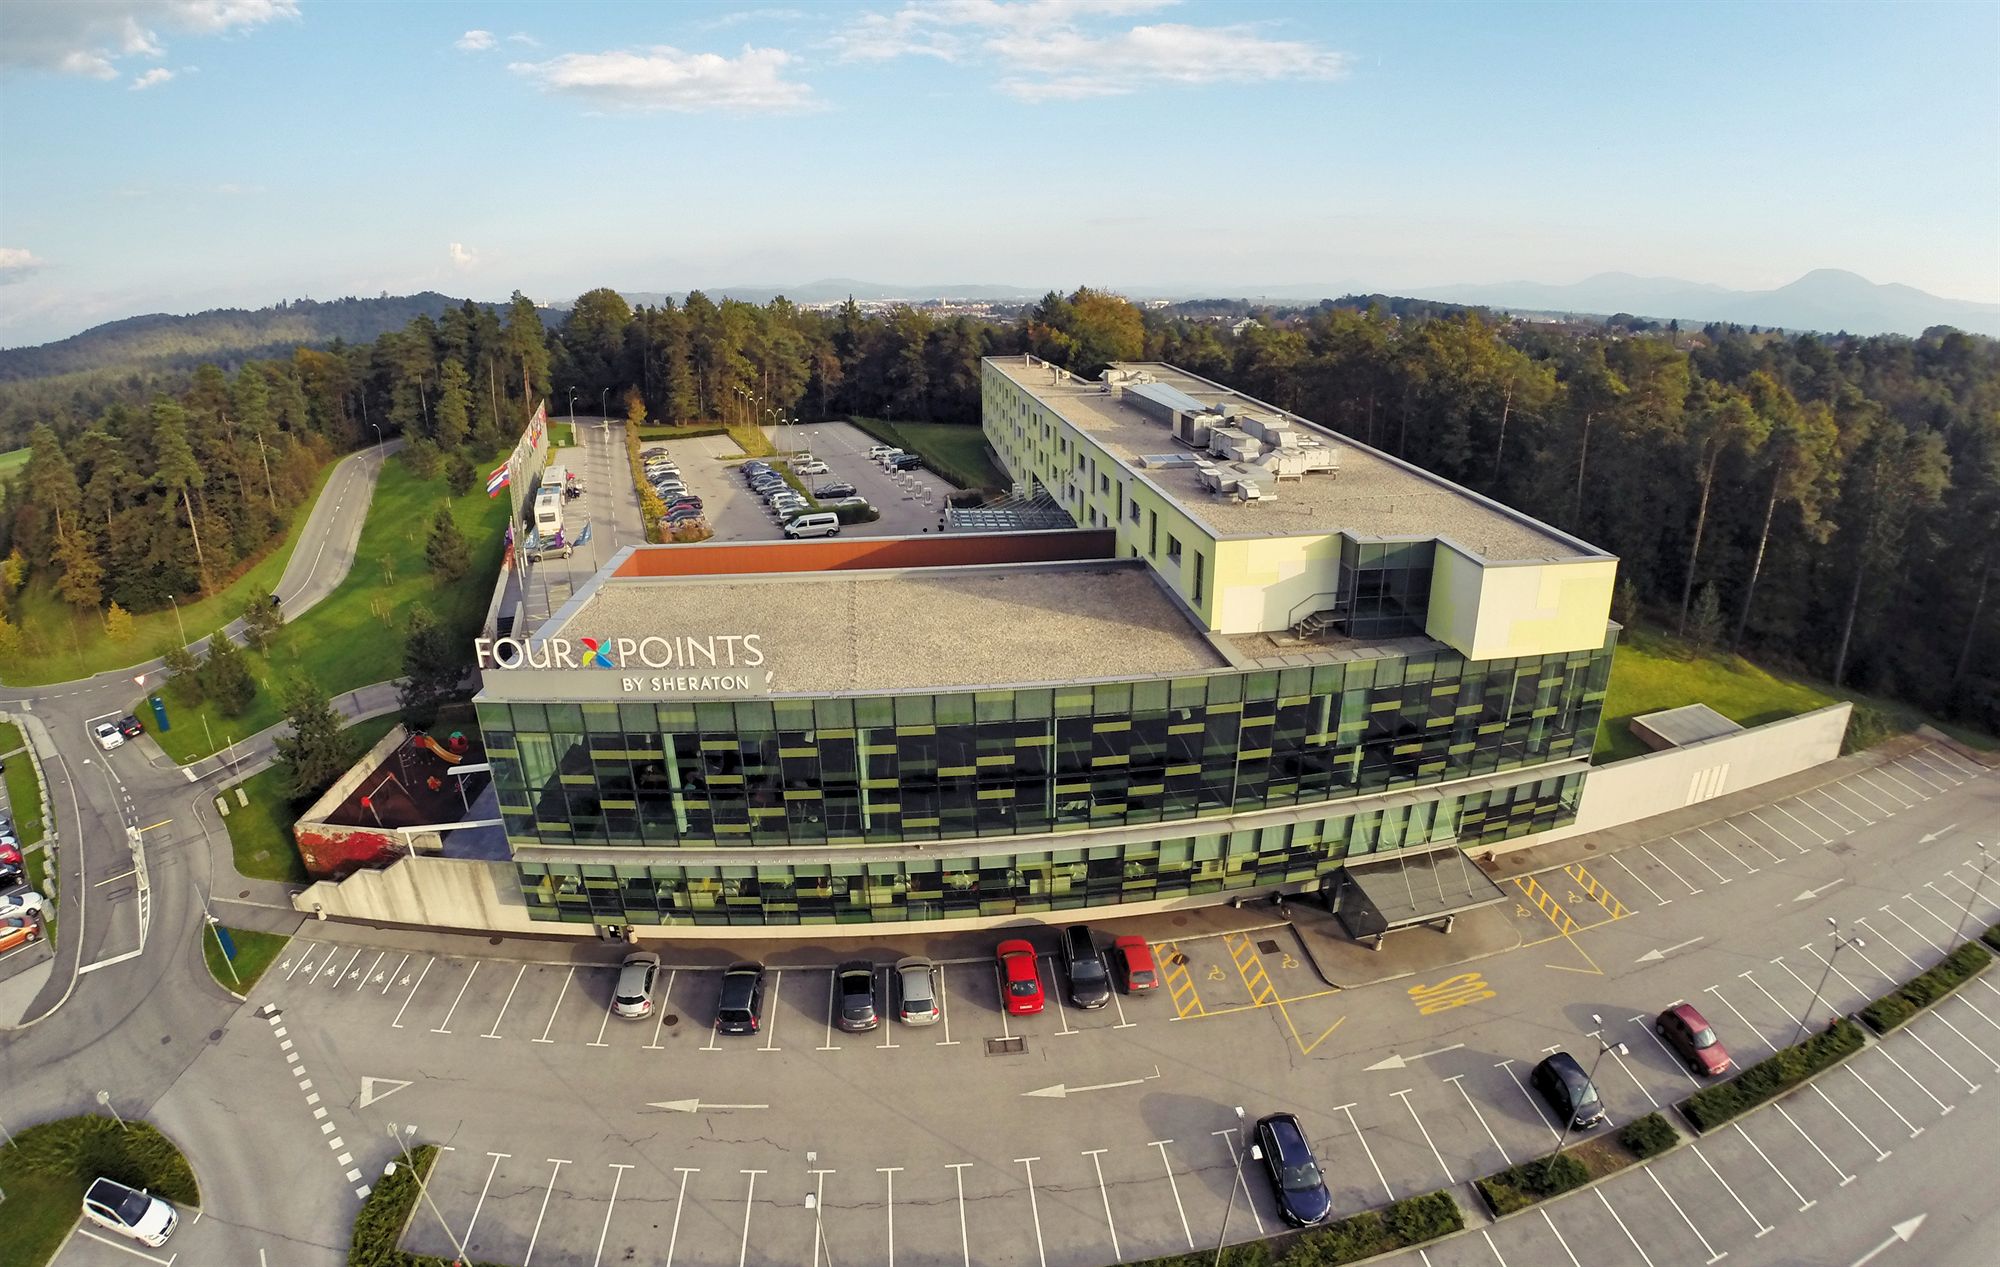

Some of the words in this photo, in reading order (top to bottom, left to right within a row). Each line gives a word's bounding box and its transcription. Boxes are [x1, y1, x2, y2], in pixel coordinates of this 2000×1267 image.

[474, 637, 578, 669] FOUR
[617, 634, 765, 668] POINTS
[622, 676, 643, 692] BY
[651, 675, 749, 692] SHERATON
[1407, 972, 1497, 1015] BUS
